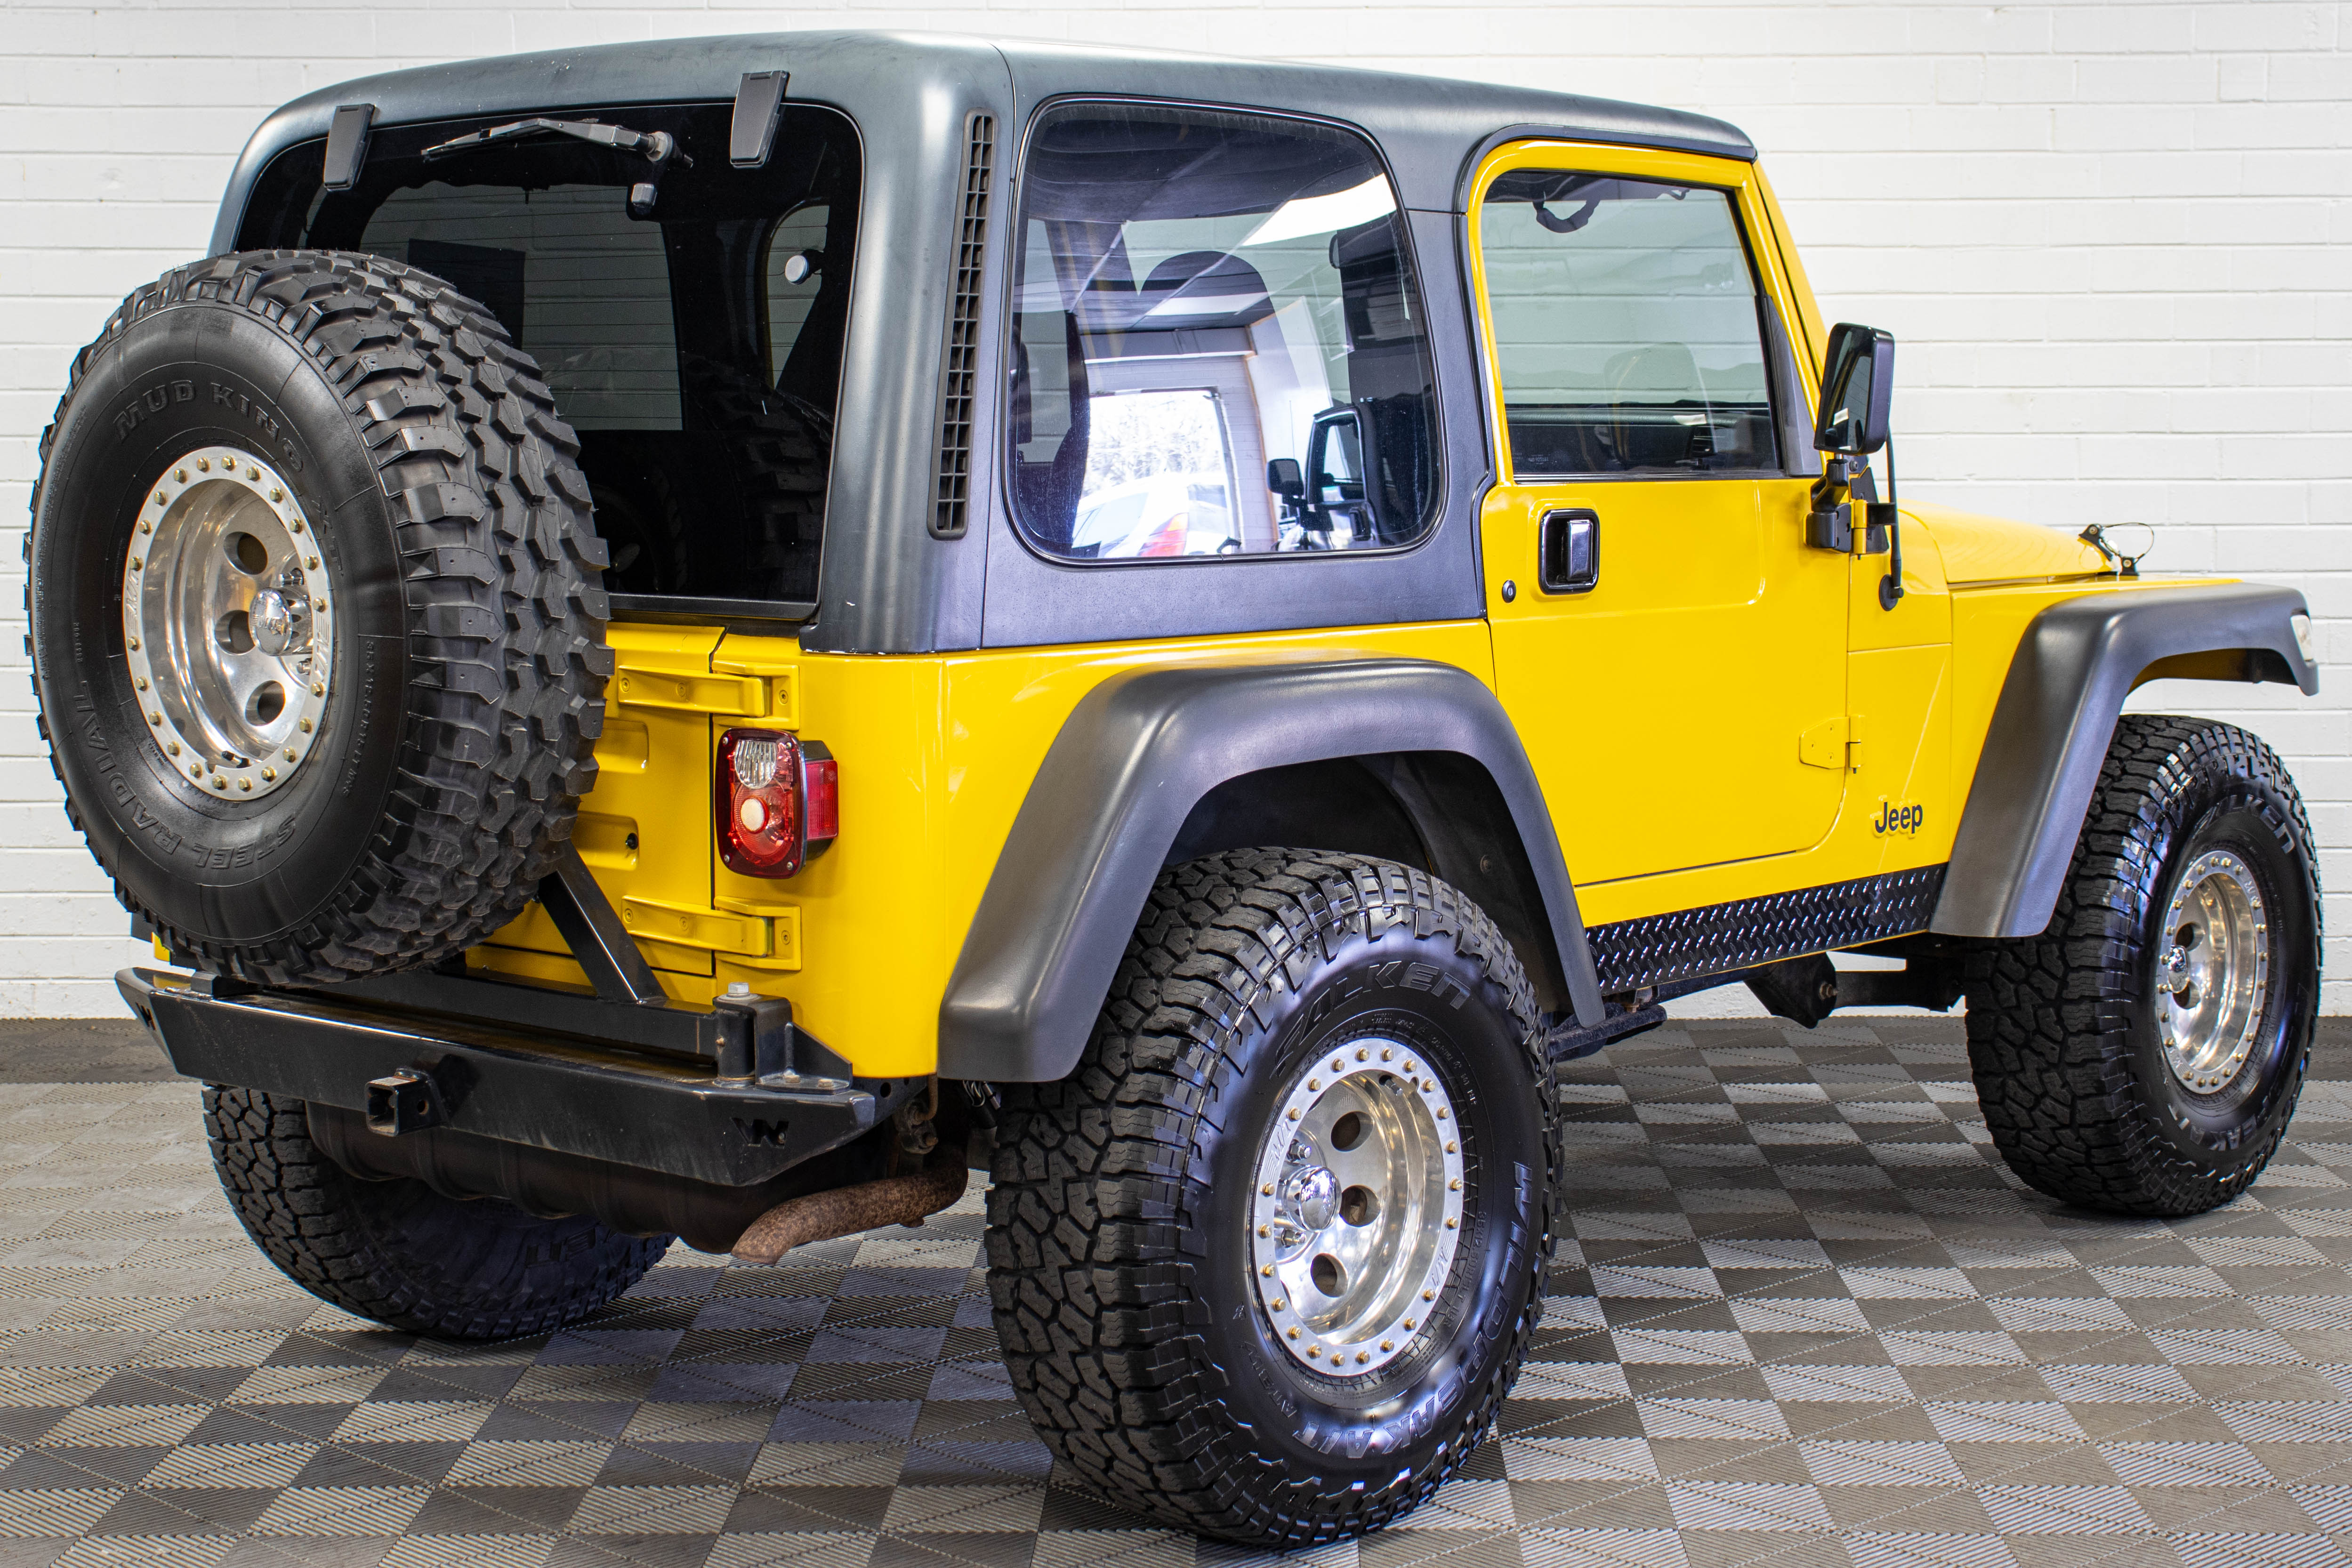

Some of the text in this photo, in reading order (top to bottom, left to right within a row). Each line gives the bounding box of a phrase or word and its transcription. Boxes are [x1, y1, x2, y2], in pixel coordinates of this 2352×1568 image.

[113, 379, 197, 443] MUD
[210, 382, 303, 472] KING
[72, 679, 297, 869] STEEL RADIAL
[1875, 802, 1923, 834] Jeep
[1269, 960, 1472, 1079] FALKEN
[1292, 1161, 1532, 1459] WILDPEAK A/T
